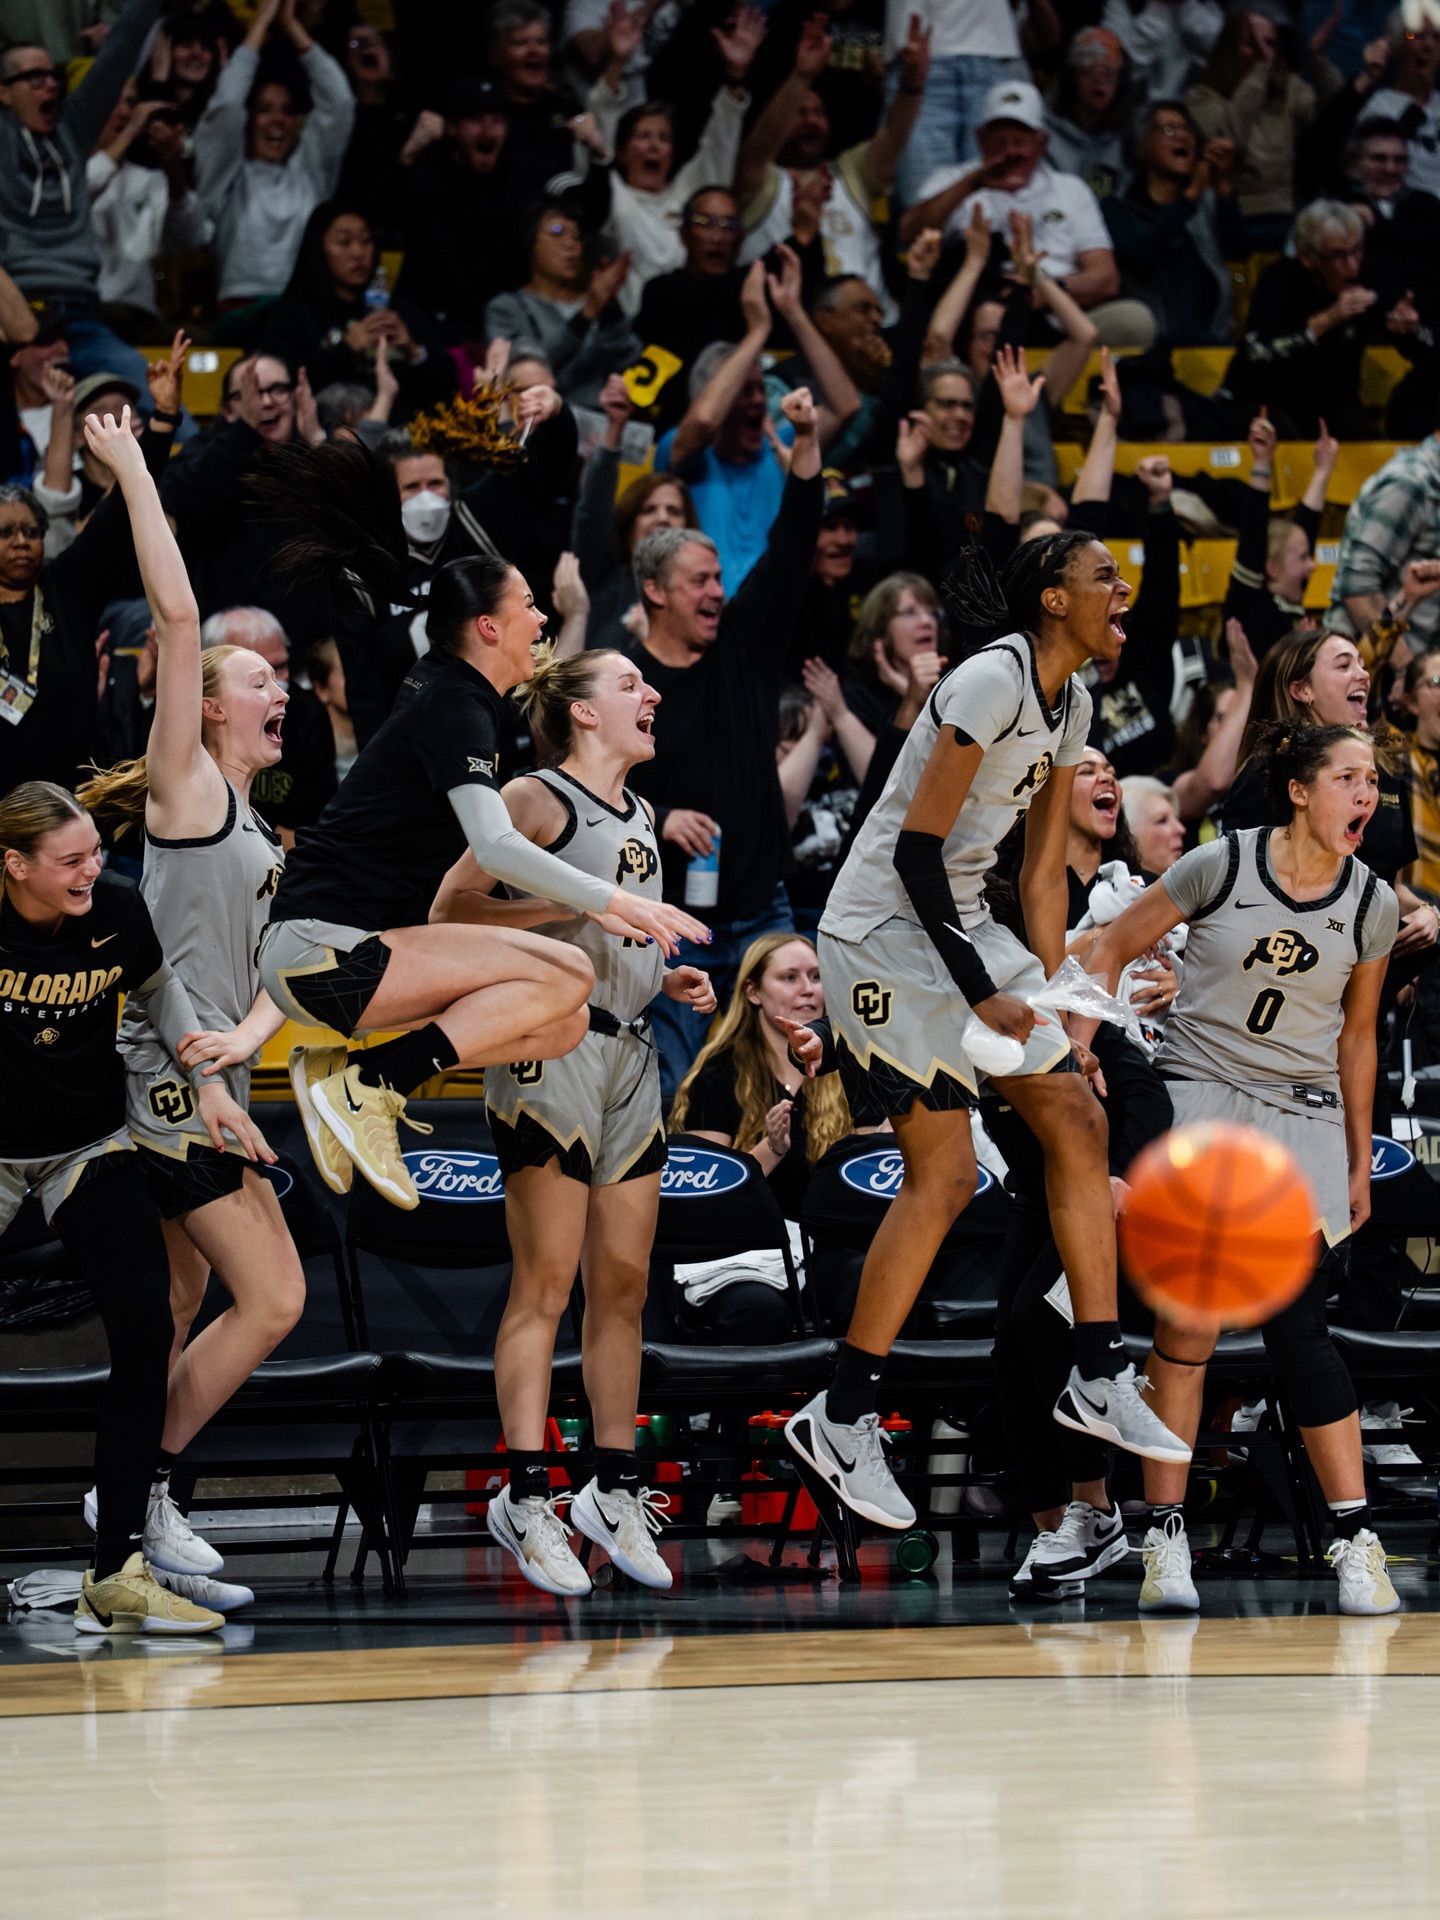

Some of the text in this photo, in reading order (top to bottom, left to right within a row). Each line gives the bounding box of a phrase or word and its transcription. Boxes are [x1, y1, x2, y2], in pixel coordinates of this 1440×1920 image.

[1266, 931, 1303, 968] CU
[0, 965, 123, 1005] OLORADO
[851, 979, 894, 1029] CU
[3, 991, 107, 1020] SKETBALL
[1245, 986, 1286, 1036] 0
[148, 1078, 195, 1127] CU
[1324, 1093, 1332, 1102] 42
[411, 1155, 502, 1194] Ford
